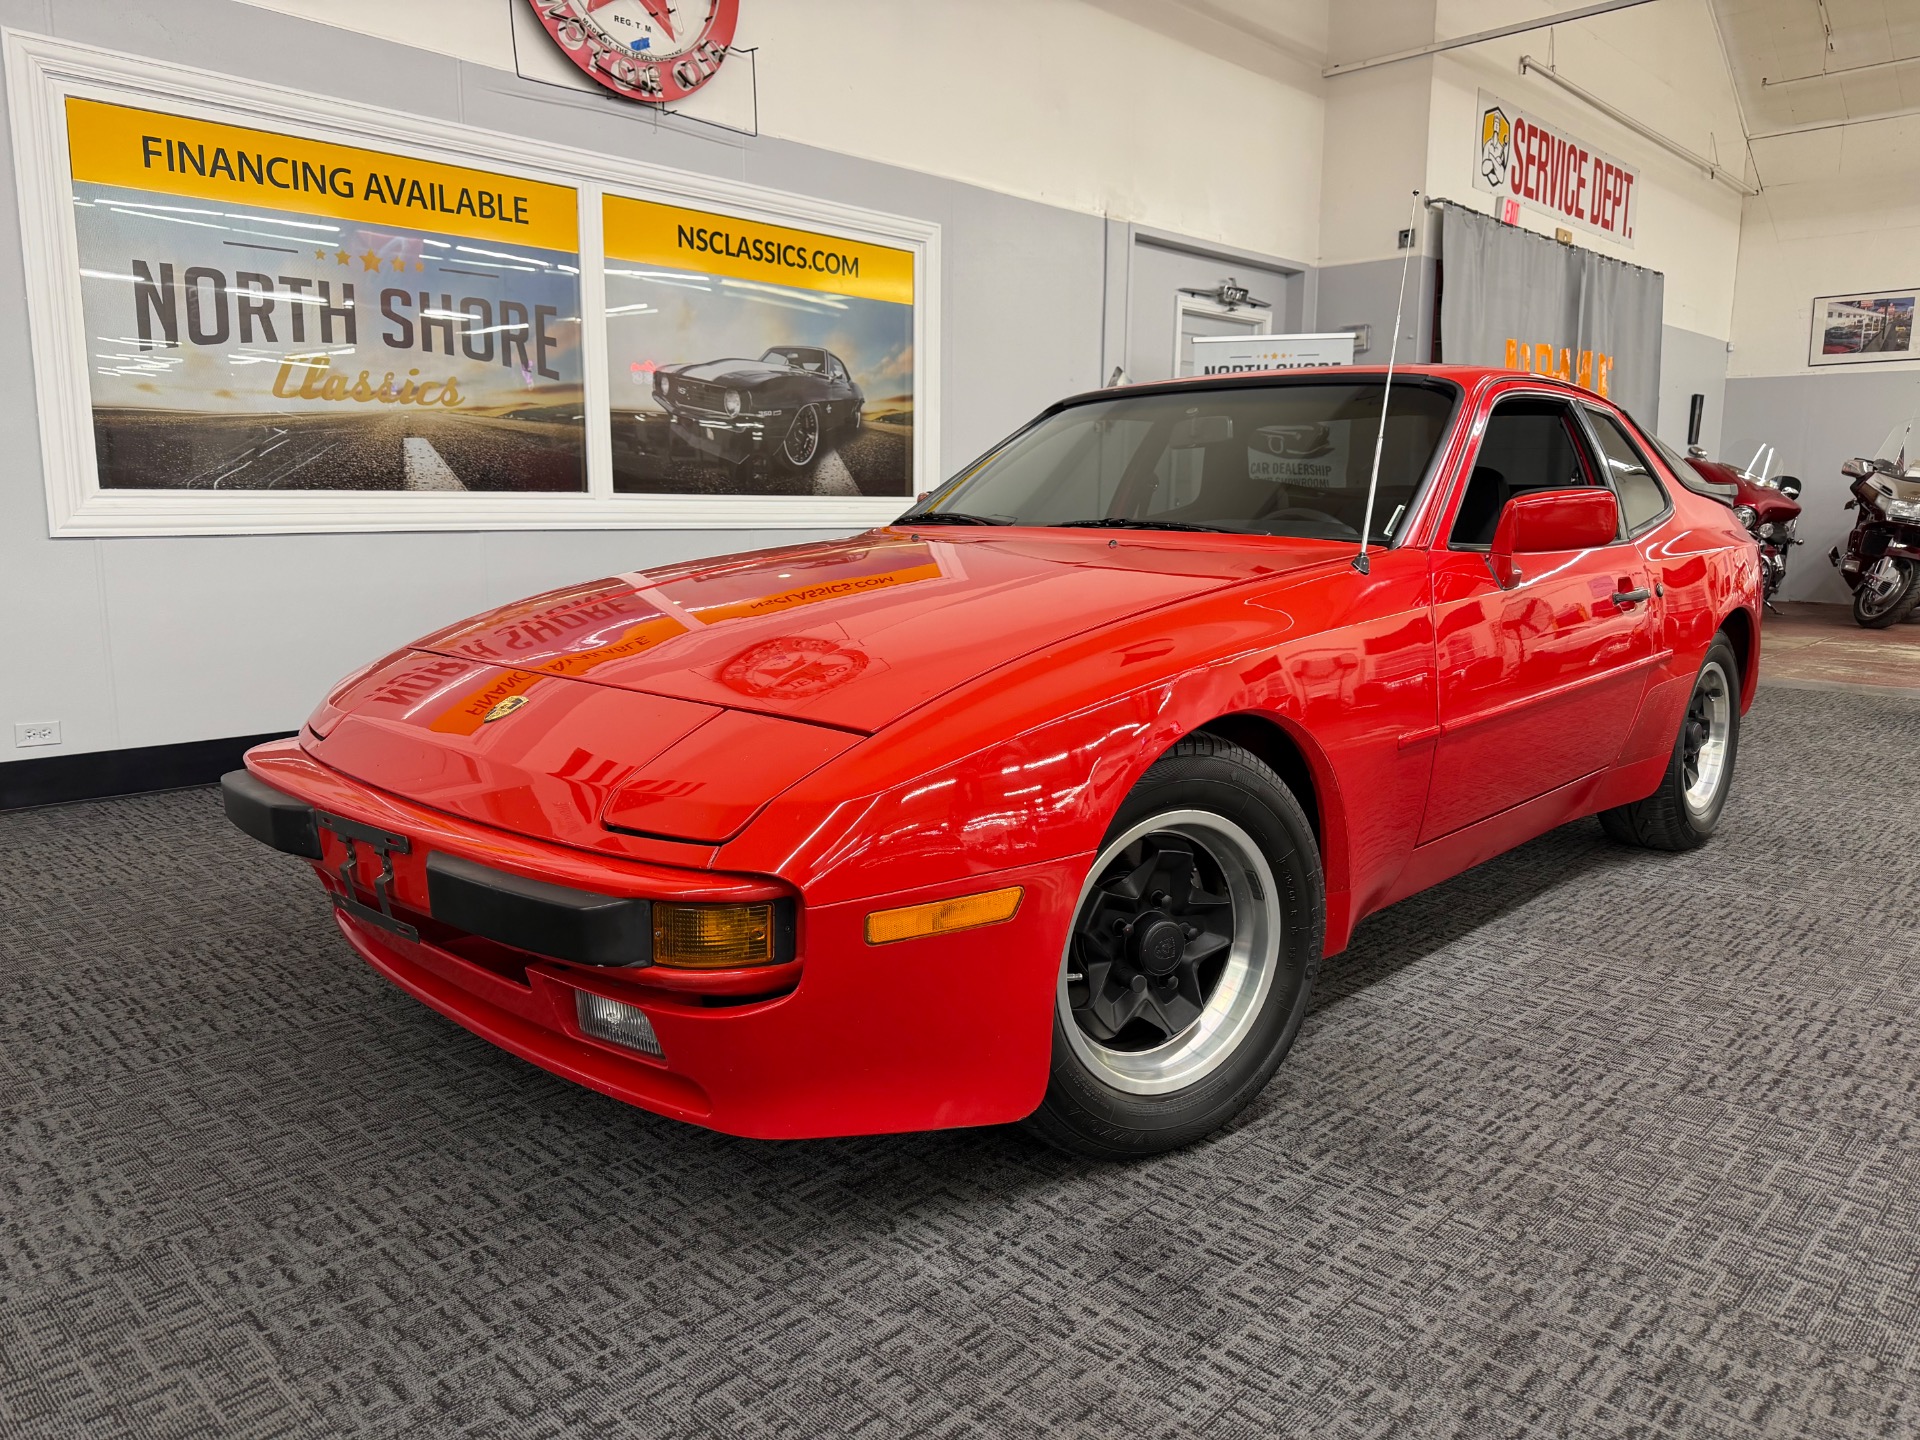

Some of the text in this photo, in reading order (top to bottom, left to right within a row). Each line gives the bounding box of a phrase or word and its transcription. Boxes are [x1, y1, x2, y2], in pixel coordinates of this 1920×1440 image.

[615, 45, 629, 57] THE
[142, 134, 529, 225] FINANCING AVAILABLE
[1511, 117, 1634, 239] SERVICE DEPT.
[677, 224, 860, 278] NSCLASSICS.COM
[132, 258, 560, 382] NORTH SHORE
[272, 352, 466, 408] Classics
[1251, 463, 1332, 477] CAR DEALERSHIP
